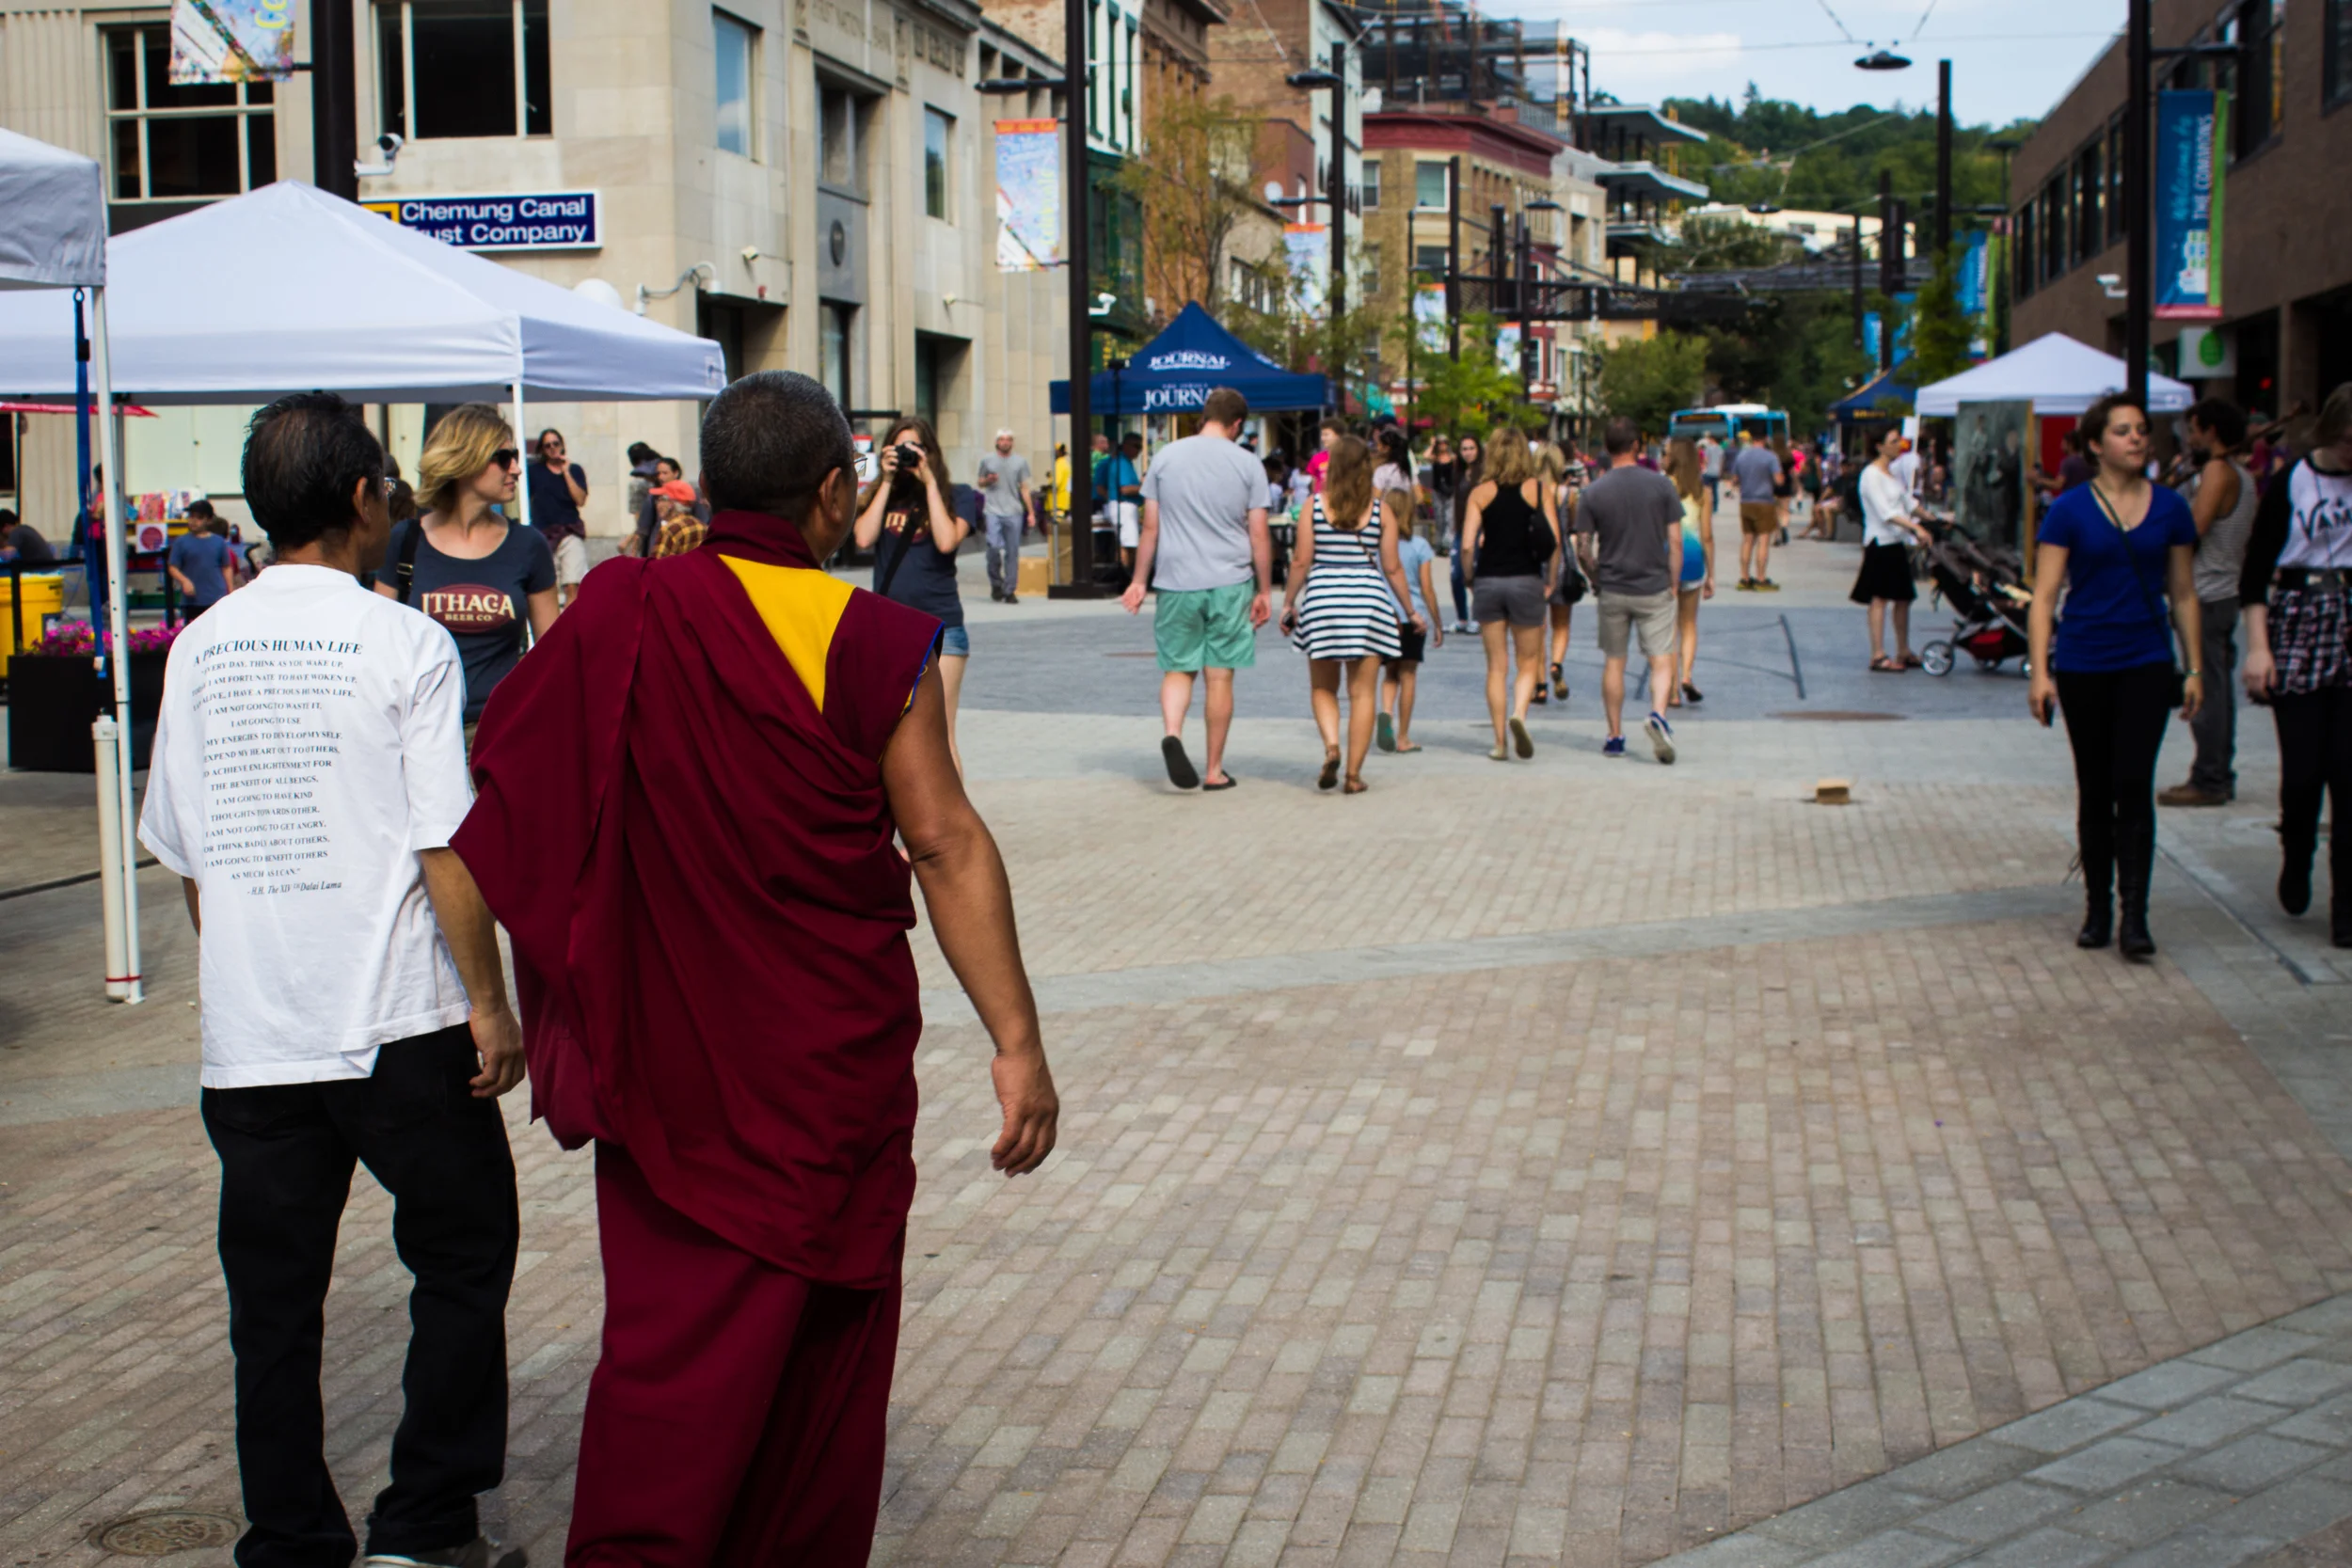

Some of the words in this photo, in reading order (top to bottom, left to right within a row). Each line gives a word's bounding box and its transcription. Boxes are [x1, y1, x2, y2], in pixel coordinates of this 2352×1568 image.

[2194, 113, 2214, 191] COMMONS
[401, 200, 514, 223] Chemung
[518, 197, 587, 218] Canal
[2192, 195, 2210, 221] THE
[405, 225, 463, 244] ust
[470, 224, 588, 245] Company
[421, 592, 516, 621] ITHACA
[444, 613, 474, 622] BEER
[193, 655, 200, 667] A
[202, 639, 269, 662] PRECIOUS
[271, 639, 326, 652] HUMAN
[326, 640, 363, 656] LIFE
[320, 880, 342, 891] Lama
